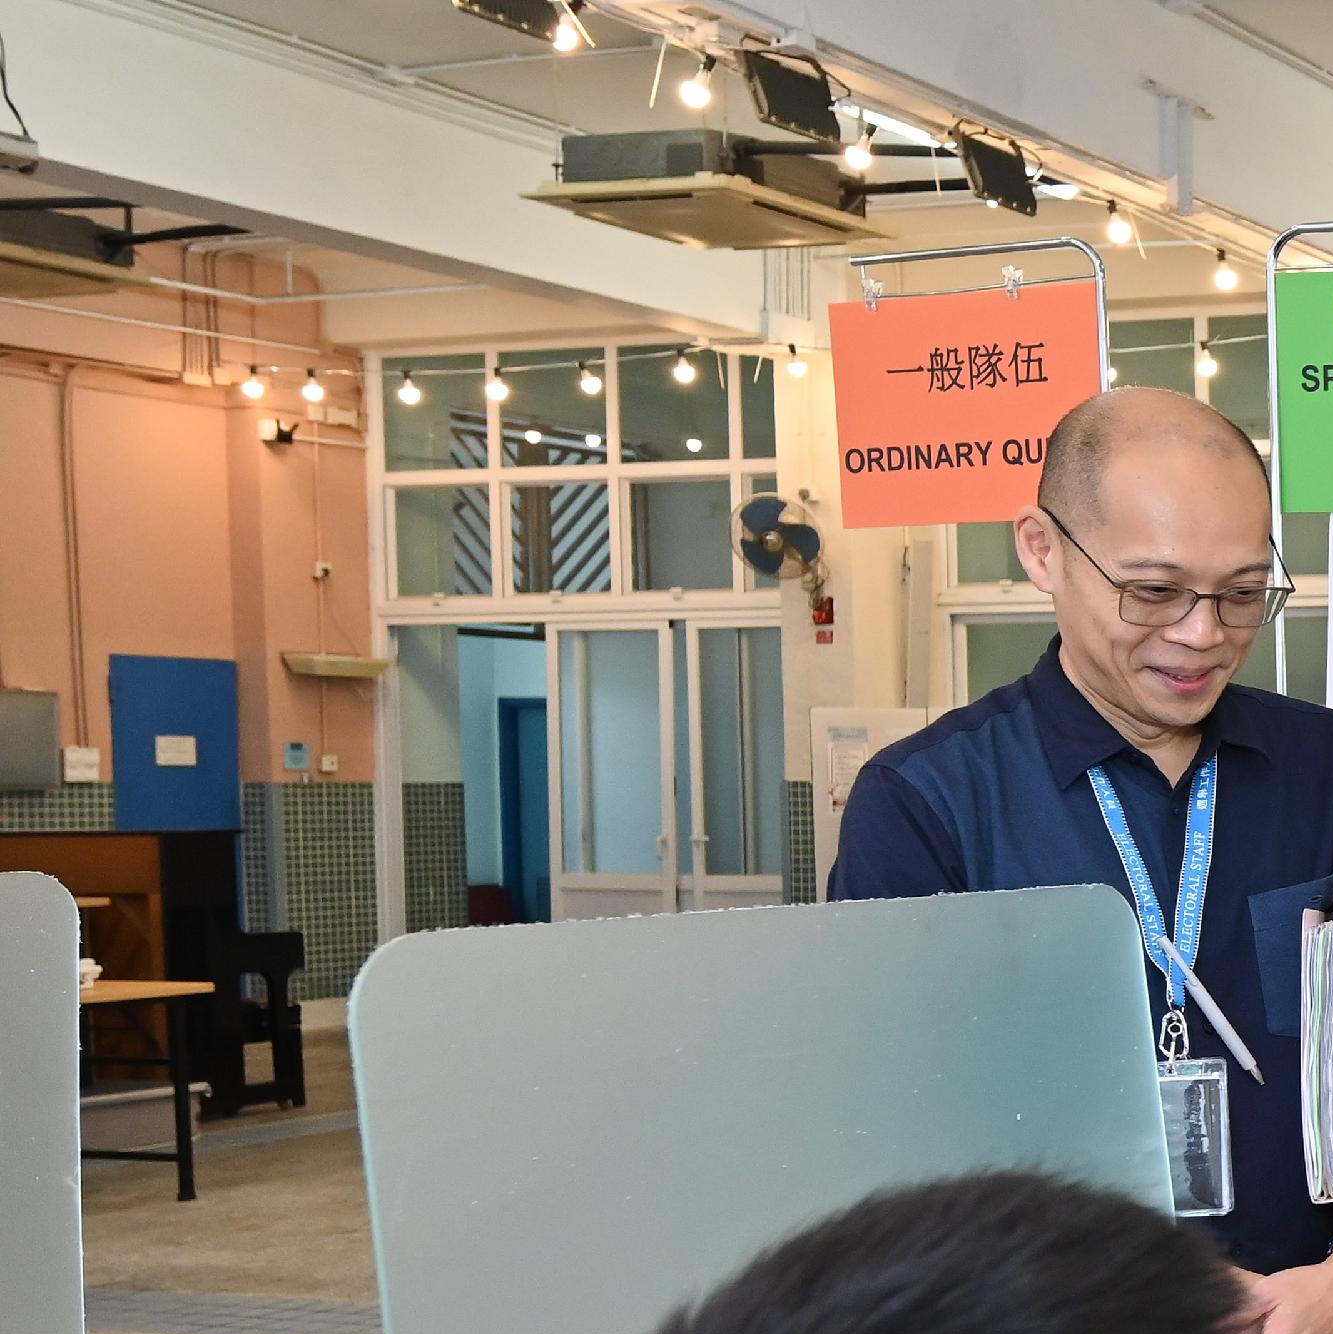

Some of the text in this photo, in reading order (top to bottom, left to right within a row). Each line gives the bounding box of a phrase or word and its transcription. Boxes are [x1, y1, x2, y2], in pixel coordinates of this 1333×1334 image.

[886, 341, 1048, 392] 一般隊伍
[844, 436, 1050, 474] ORDINARY QU
[1117, 832, 1154, 911] ELECTORAL
[1180, 831, 1205, 953] ELECTORAL STAFF
